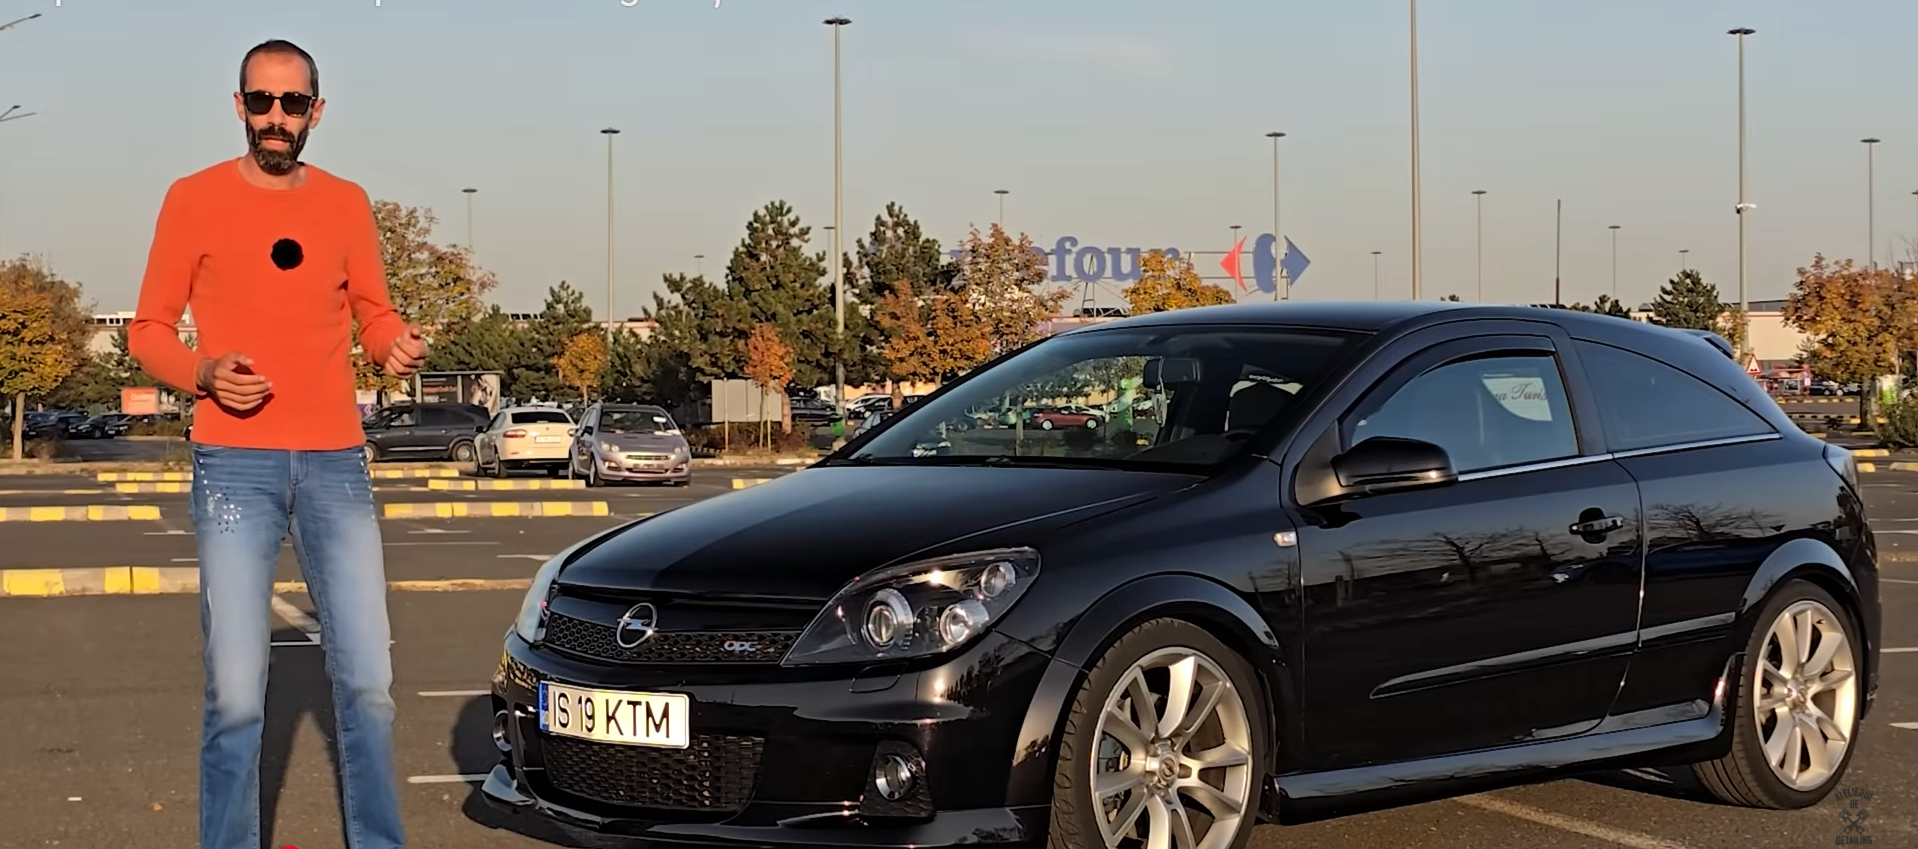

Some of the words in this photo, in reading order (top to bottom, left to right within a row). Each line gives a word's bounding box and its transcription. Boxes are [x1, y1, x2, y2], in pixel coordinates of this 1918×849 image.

[553, 691, 570, 728] IS
[578, 695, 596, 733] 19
[606, 698, 670, 739] KTM
